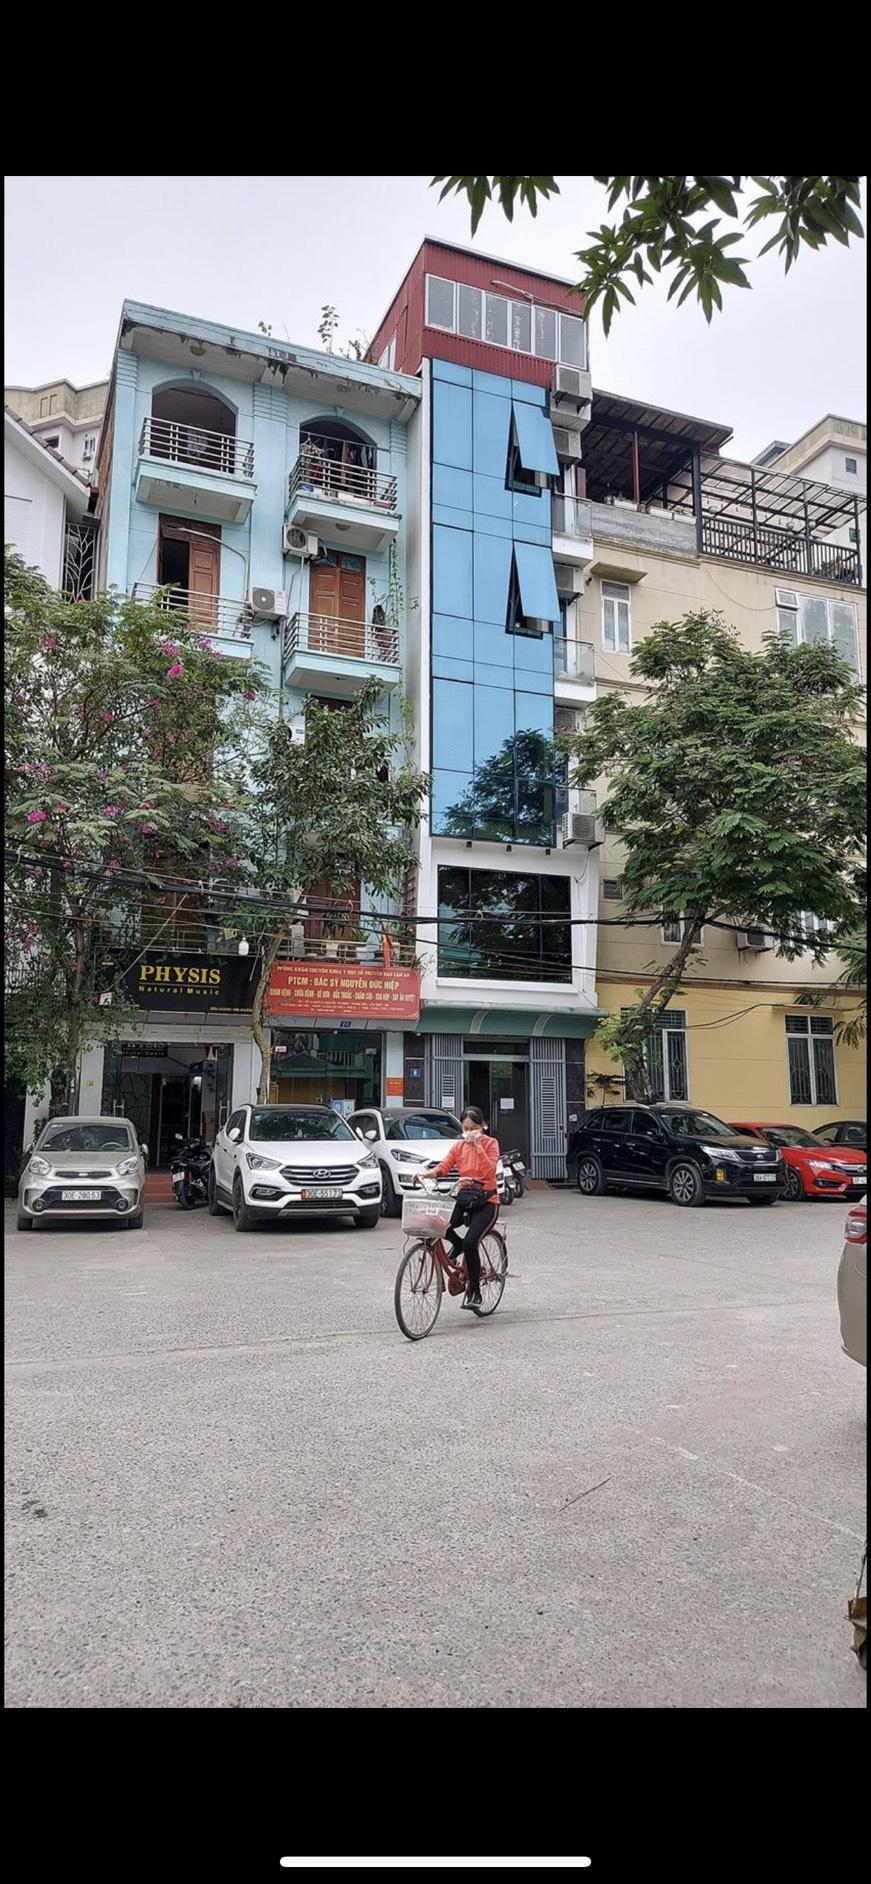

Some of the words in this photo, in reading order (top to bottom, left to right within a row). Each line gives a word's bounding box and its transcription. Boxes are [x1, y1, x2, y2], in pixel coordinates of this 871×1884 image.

[139, 965, 220, 984] PHYSIS
[139, 985, 183, 994] Natural
[187, 987, 219, 995] Music
[313, 976, 328, 987] BÁC
[340, 976, 368, 989] NGUYỄN
[384, 979, 400, 991] HIỆP
